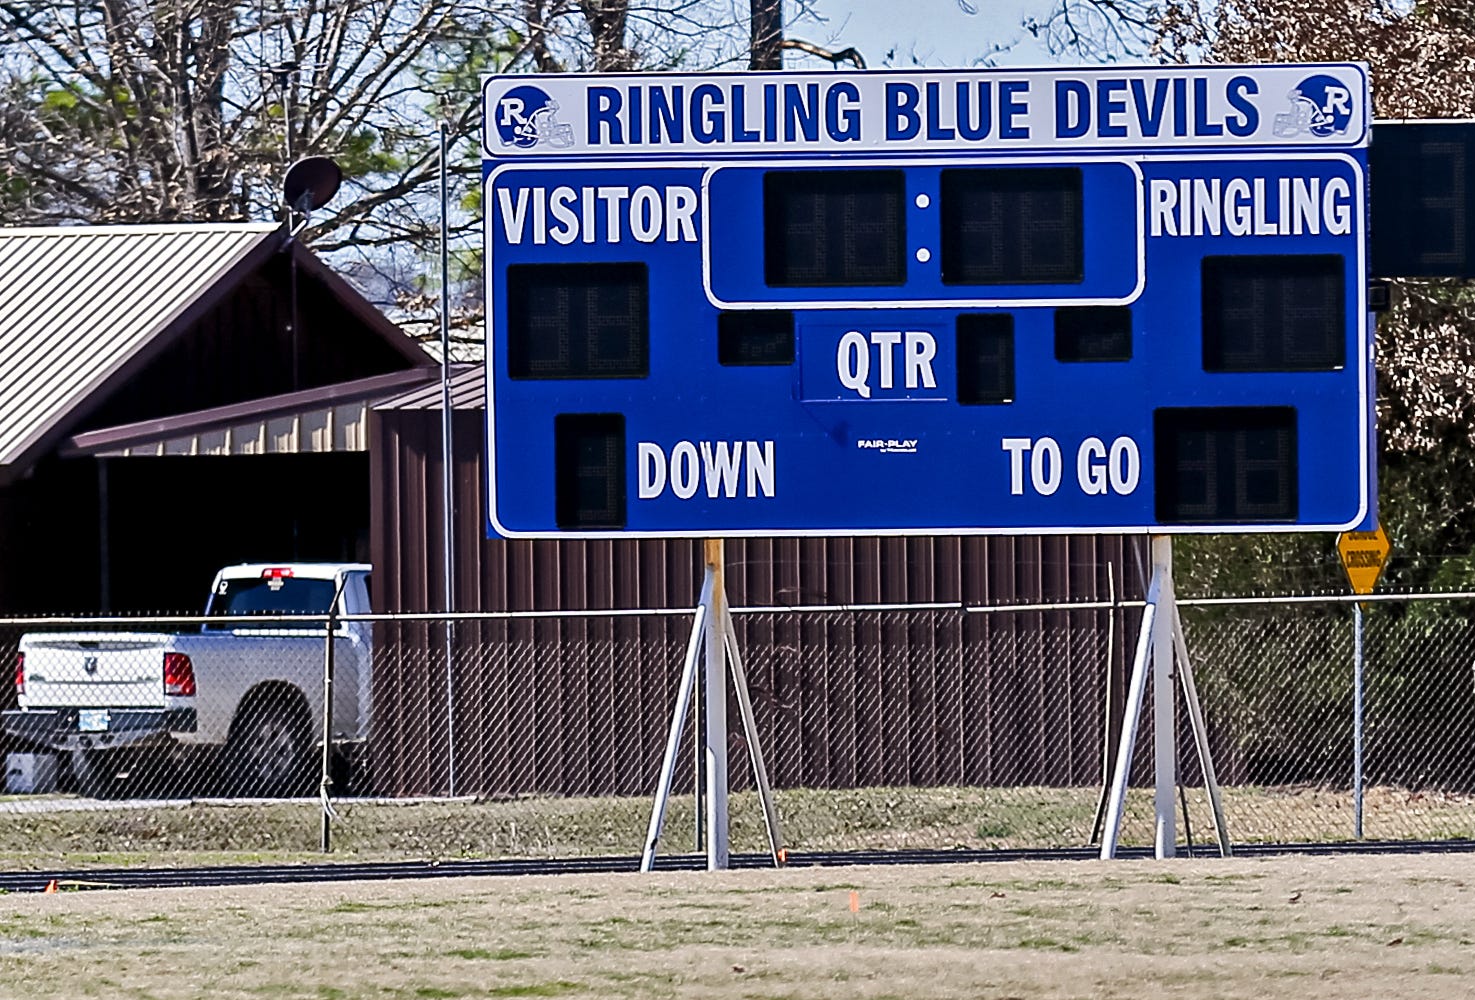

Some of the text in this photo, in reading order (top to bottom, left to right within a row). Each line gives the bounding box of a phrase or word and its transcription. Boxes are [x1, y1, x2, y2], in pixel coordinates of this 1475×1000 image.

[500, 98, 527, 126] R
[586, 75, 1260, 146] RINGLING BLUE DEVILS
[1322, 85, 1351, 115] R
[497, 185, 697, 245] VISITOR
[1150, 177, 1351, 237] RINGLING
[837, 331, 938, 399] QTR
[638, 440, 775, 500] DOWN
[1001, 436, 1140, 496] TO GO
[1346, 550, 1381, 568] CROSSING
